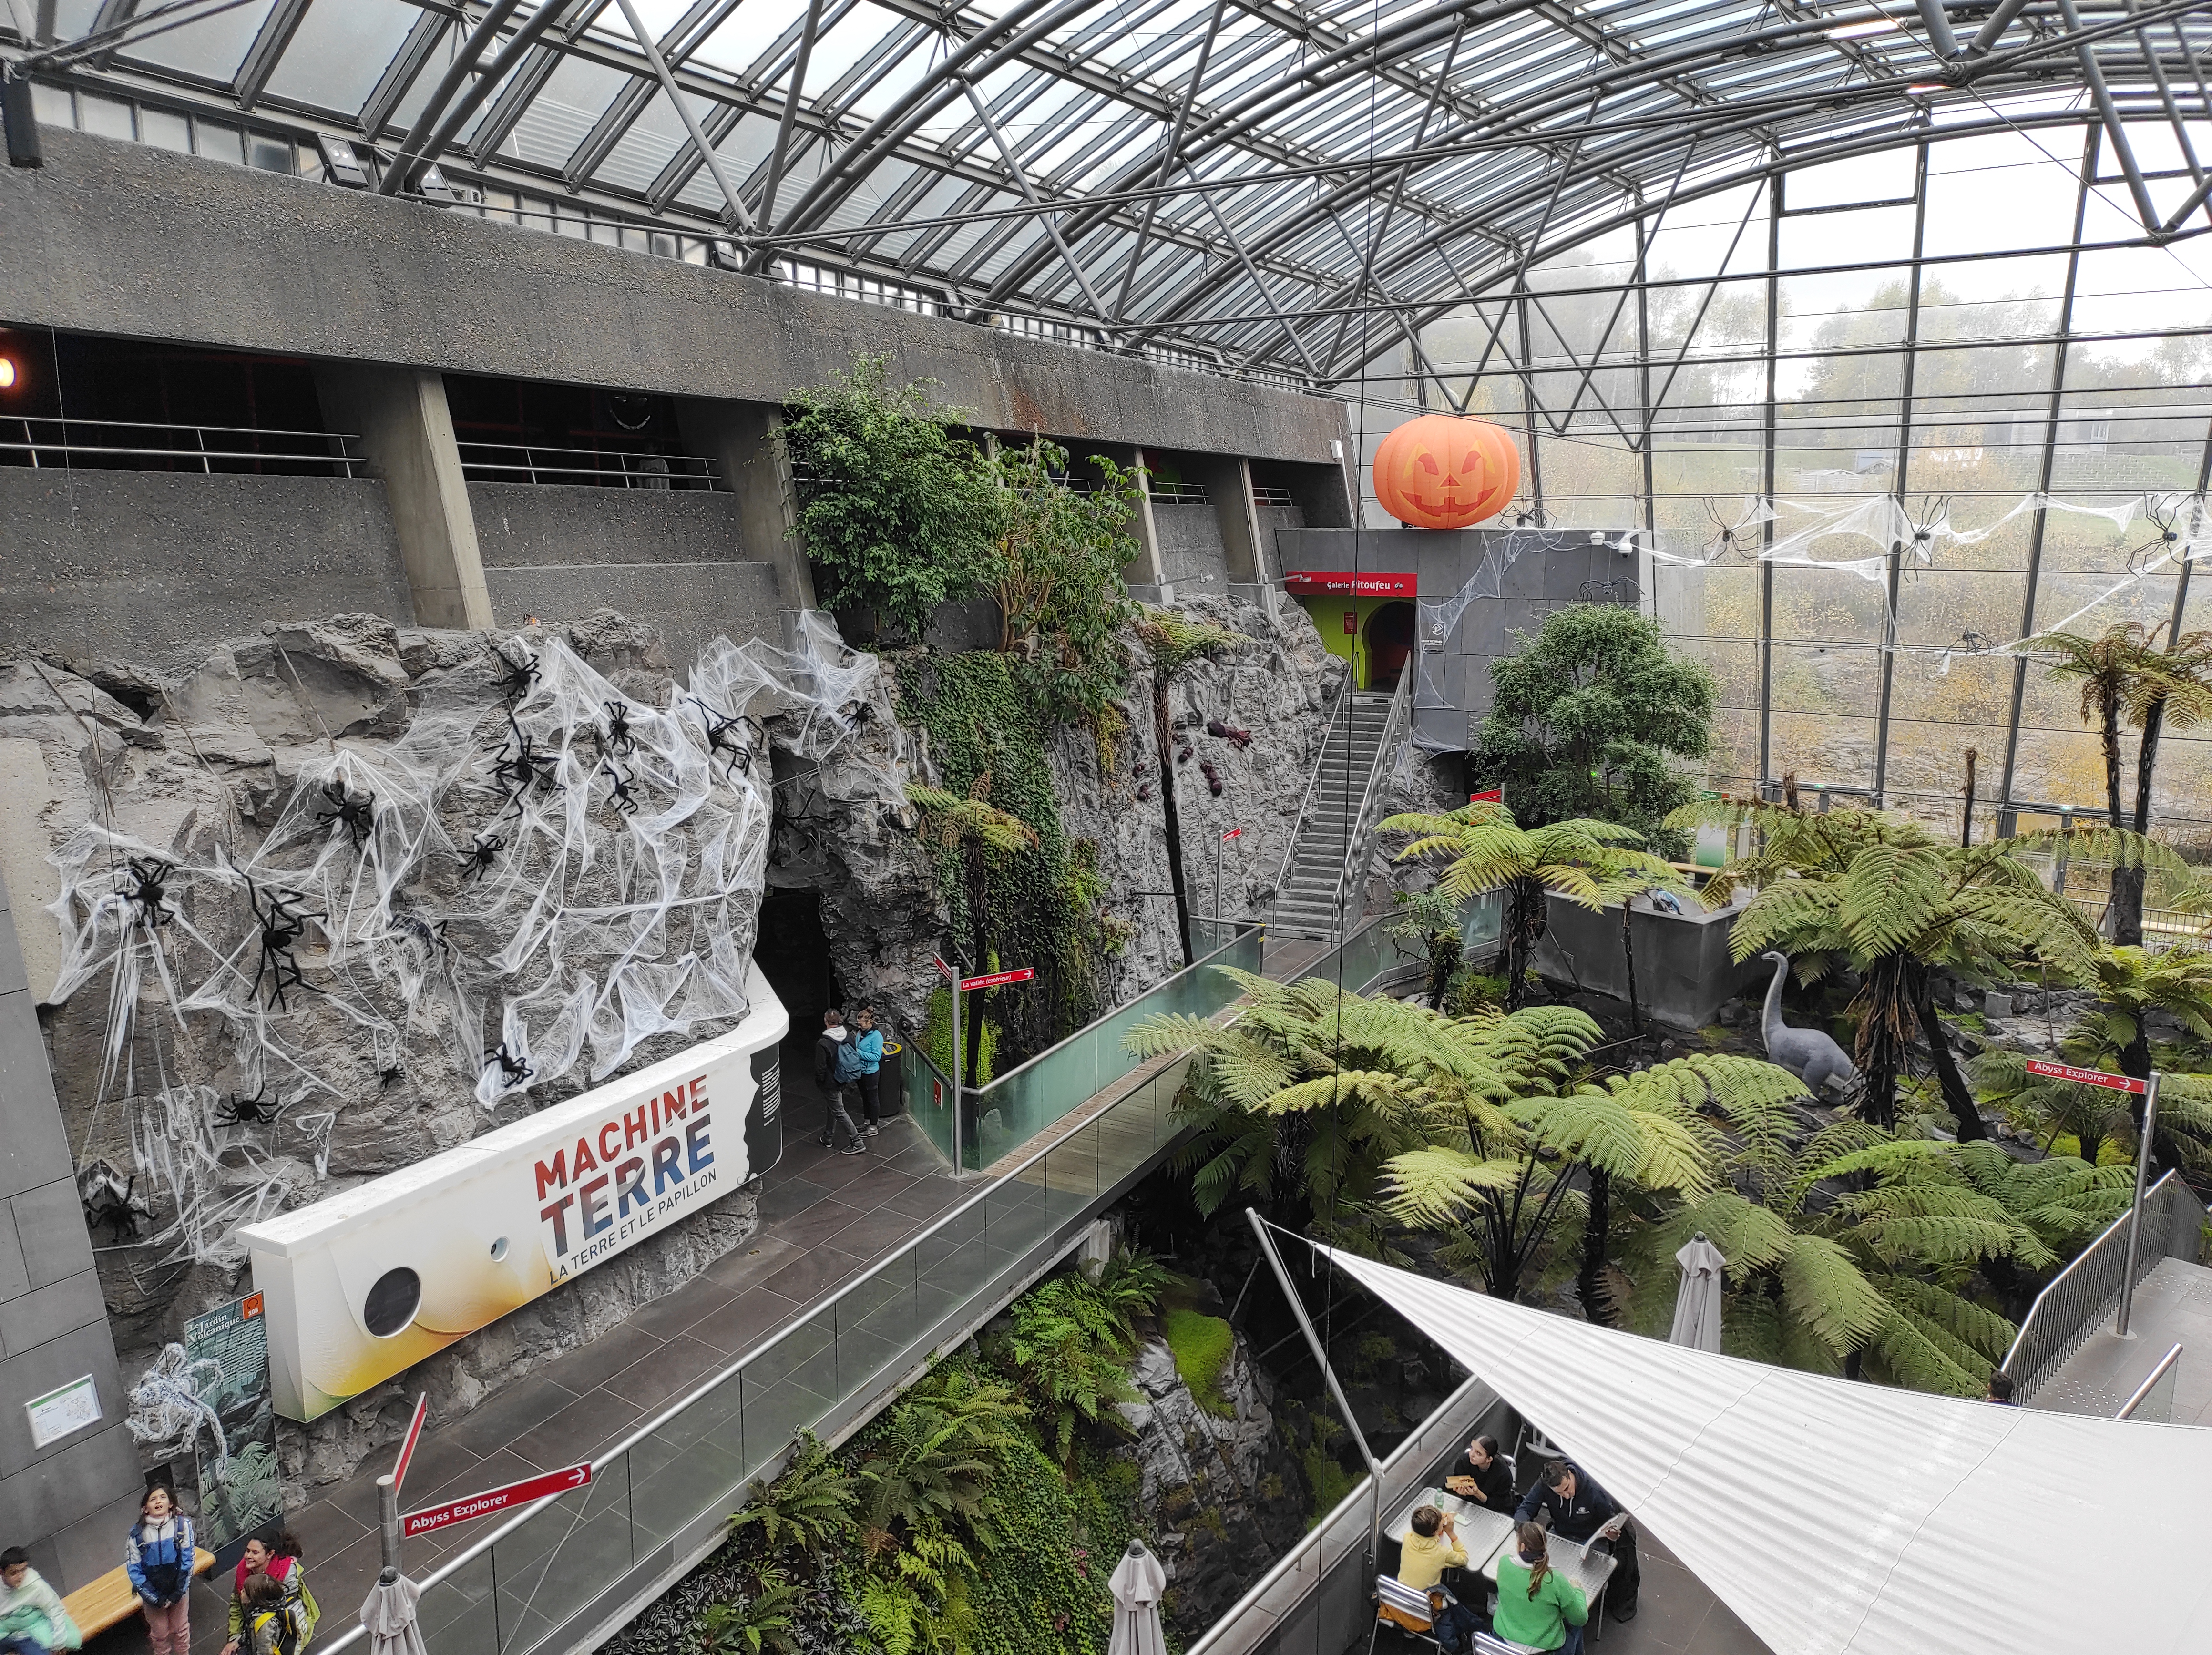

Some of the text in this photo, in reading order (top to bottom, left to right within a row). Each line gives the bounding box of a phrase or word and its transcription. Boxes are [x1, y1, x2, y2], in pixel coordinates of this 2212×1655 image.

[1352, 579, 1390, 591] Pitoufeu
[986, 974, 1011, 984] (extérieur)
[2035, 1062, 2108, 1083] Abyss Explorer
[534, 1074, 709, 1201] MACHINE
[541, 1113, 715, 1258] TERRE
[550, 1168, 717, 1286] LA TERRE ET LE PAPILLON
[198, 1314, 227, 1334] Jardin
[248, 1308, 259, 1317] 108
[187, 1317, 240, 1343] Volcanique
[411, 1494, 508, 1530] Abyss Explorer
